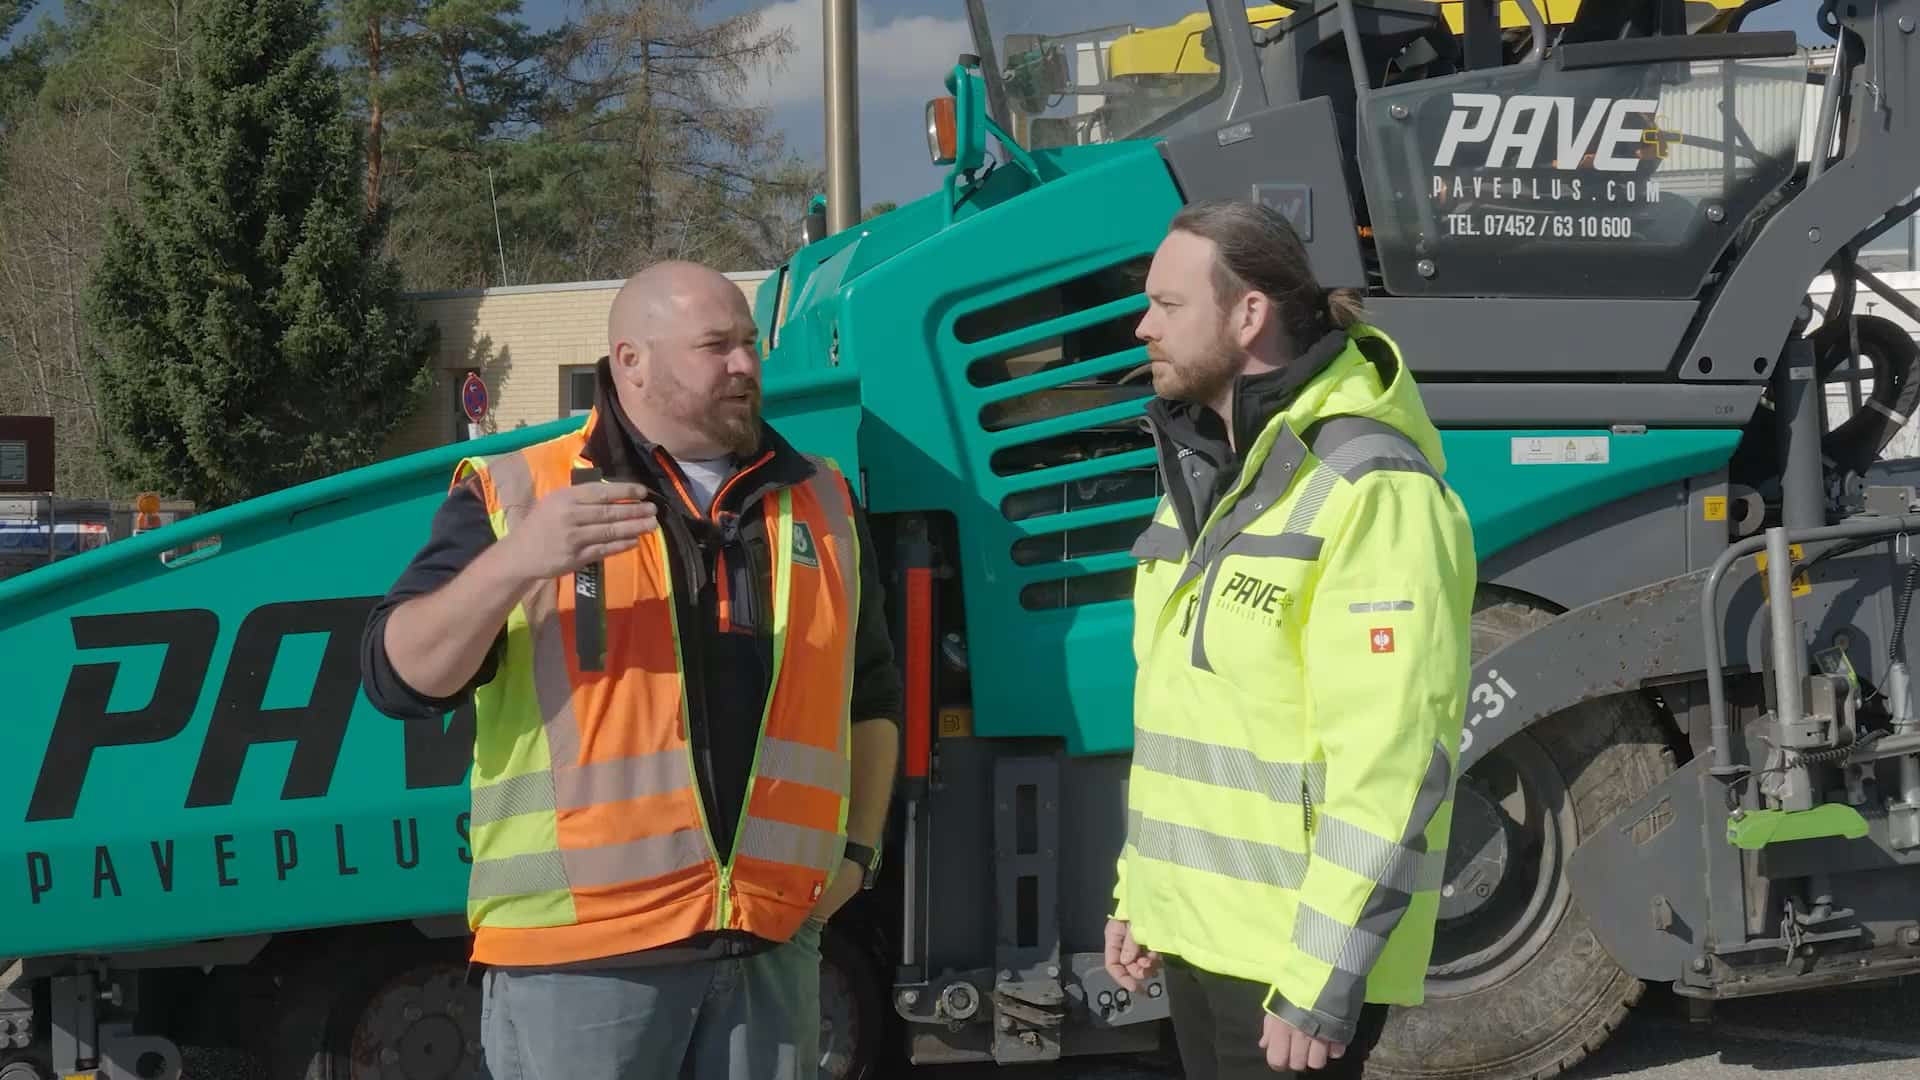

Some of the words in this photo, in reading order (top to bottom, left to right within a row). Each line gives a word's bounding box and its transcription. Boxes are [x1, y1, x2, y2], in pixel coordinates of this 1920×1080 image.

[1433, 93, 1658, 171] PAVE
[1447, 214, 1481, 236] TEL.
[1484, 214, 1536, 236] 07452
[1539, 215, 1550, 236] /
[1553, 216, 1574, 237] 63
[1578, 216, 1598, 237] 10
[1601, 217, 1632, 238] 600
